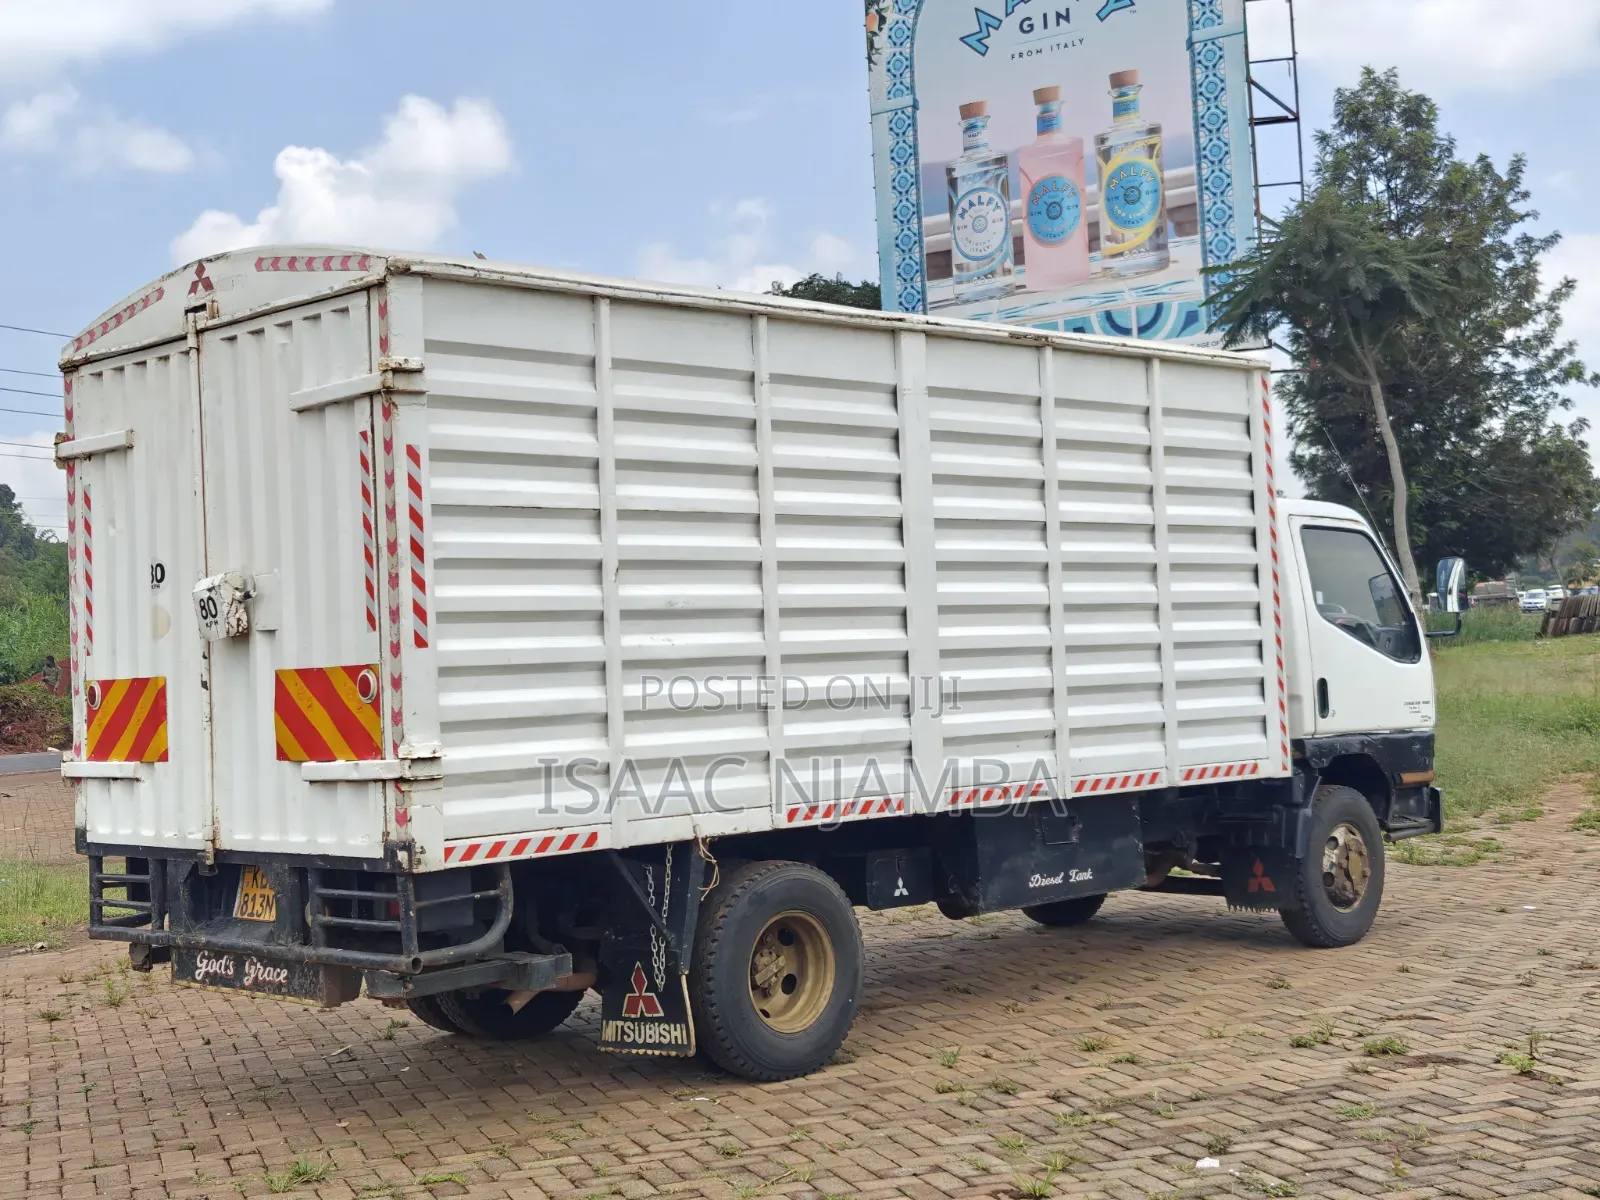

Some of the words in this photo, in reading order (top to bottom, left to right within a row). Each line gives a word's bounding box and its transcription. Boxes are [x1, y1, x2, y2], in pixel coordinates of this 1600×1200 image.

[1019, 7, 1071, 35] GIN
[1010, 49, 1043, 61] FROM
[1050, 38, 1085, 52] ITALY
[1109, 166, 1155, 191] MALFY
[1032, 181, 1077, 206] MALFY
[958, 195, 1001, 220] MALFY
[199, 595, 218, 620] 80
[205, 620, 219, 631] KPH
[1028, 871, 1064, 888] Diesel
[1068, 867, 1093, 882] Tank
[240, 892, 276, 919] 813N
[195, 949, 235, 980] God's
[243, 955, 288, 987] Grace
[601, 1019, 688, 1045] MITSUBISHI
